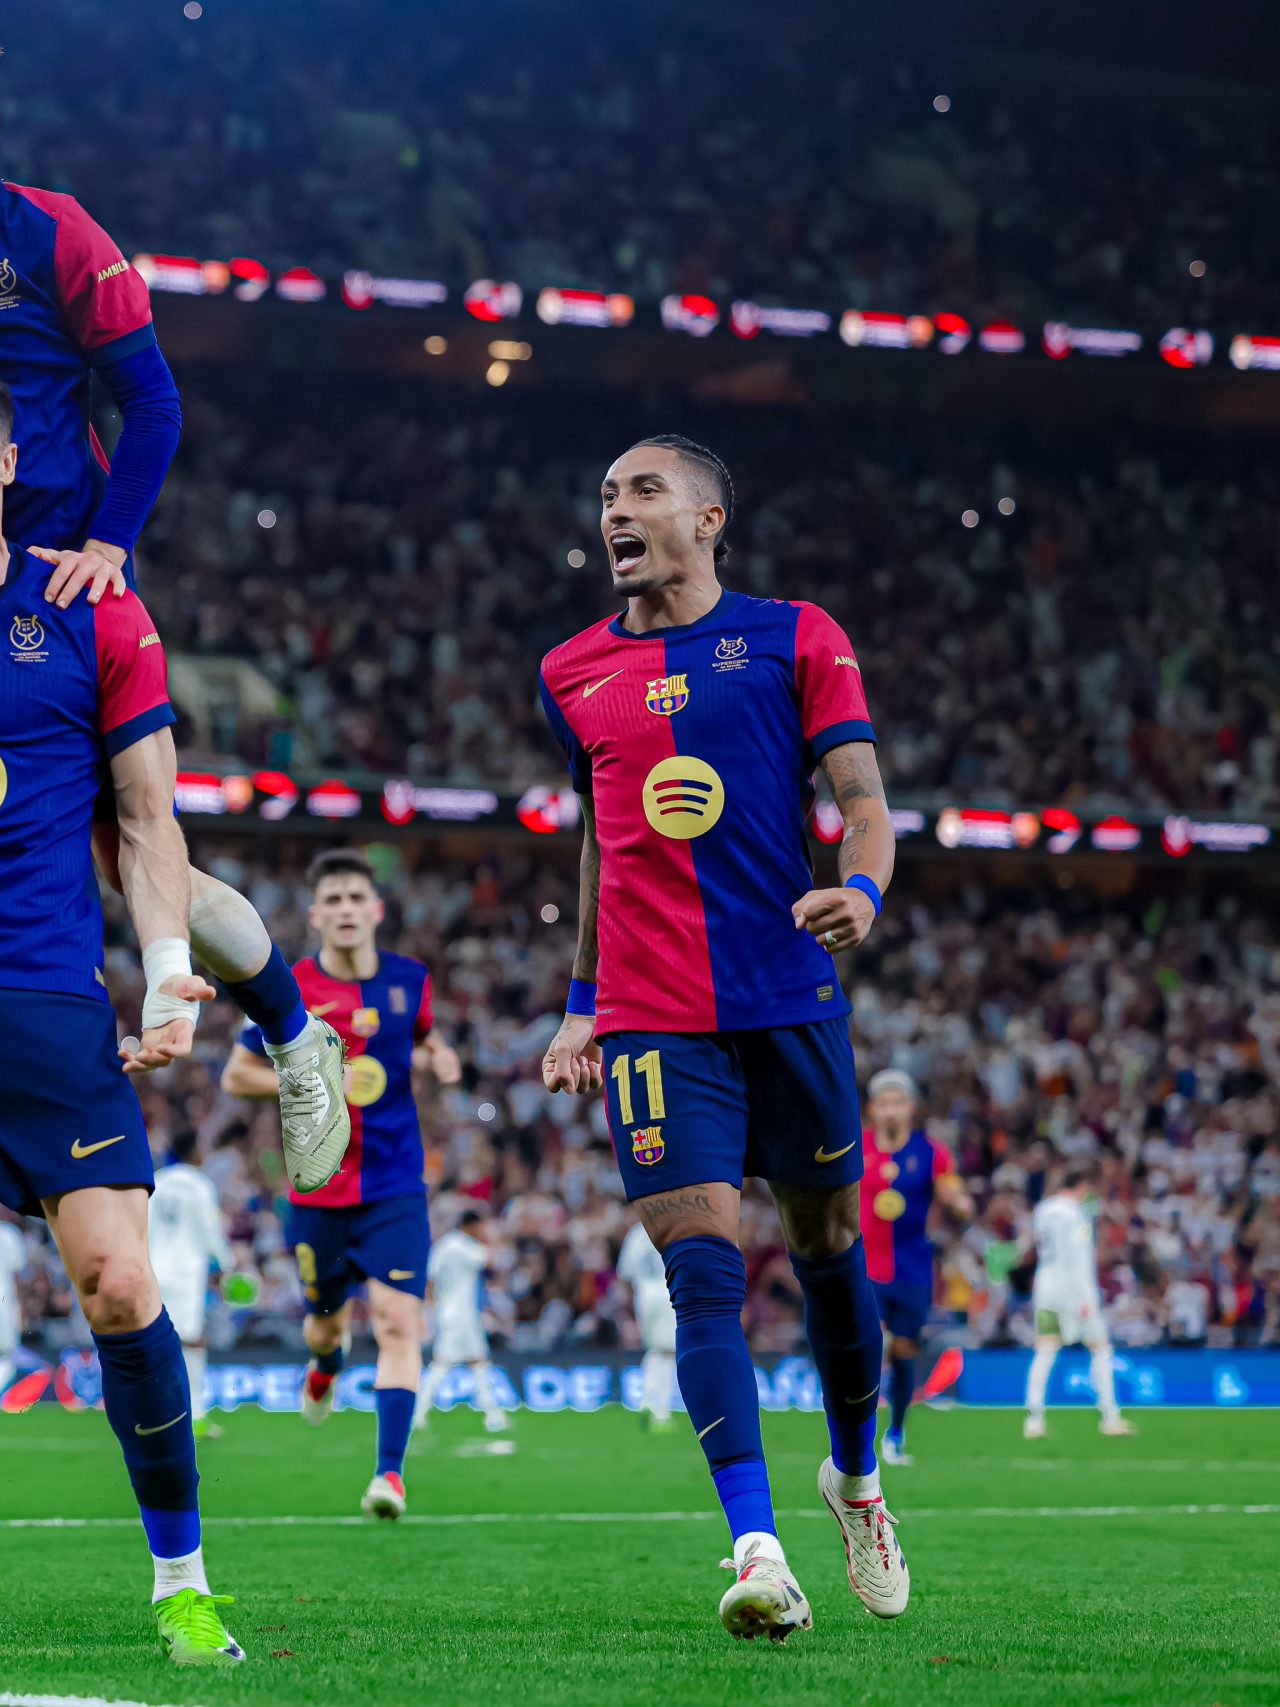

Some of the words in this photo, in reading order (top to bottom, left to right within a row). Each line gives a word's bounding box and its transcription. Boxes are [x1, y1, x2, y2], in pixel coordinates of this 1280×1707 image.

[711, 658, 750, 668] SUPERCOPA
[658, 690, 676, 698] FCB
[611, 1049, 666, 1126] 11
[310, 1137, 326, 1157] UNDER
[325, 1114, 343, 1138] ARMOUR
[523, 1364, 613, 1411] DE
